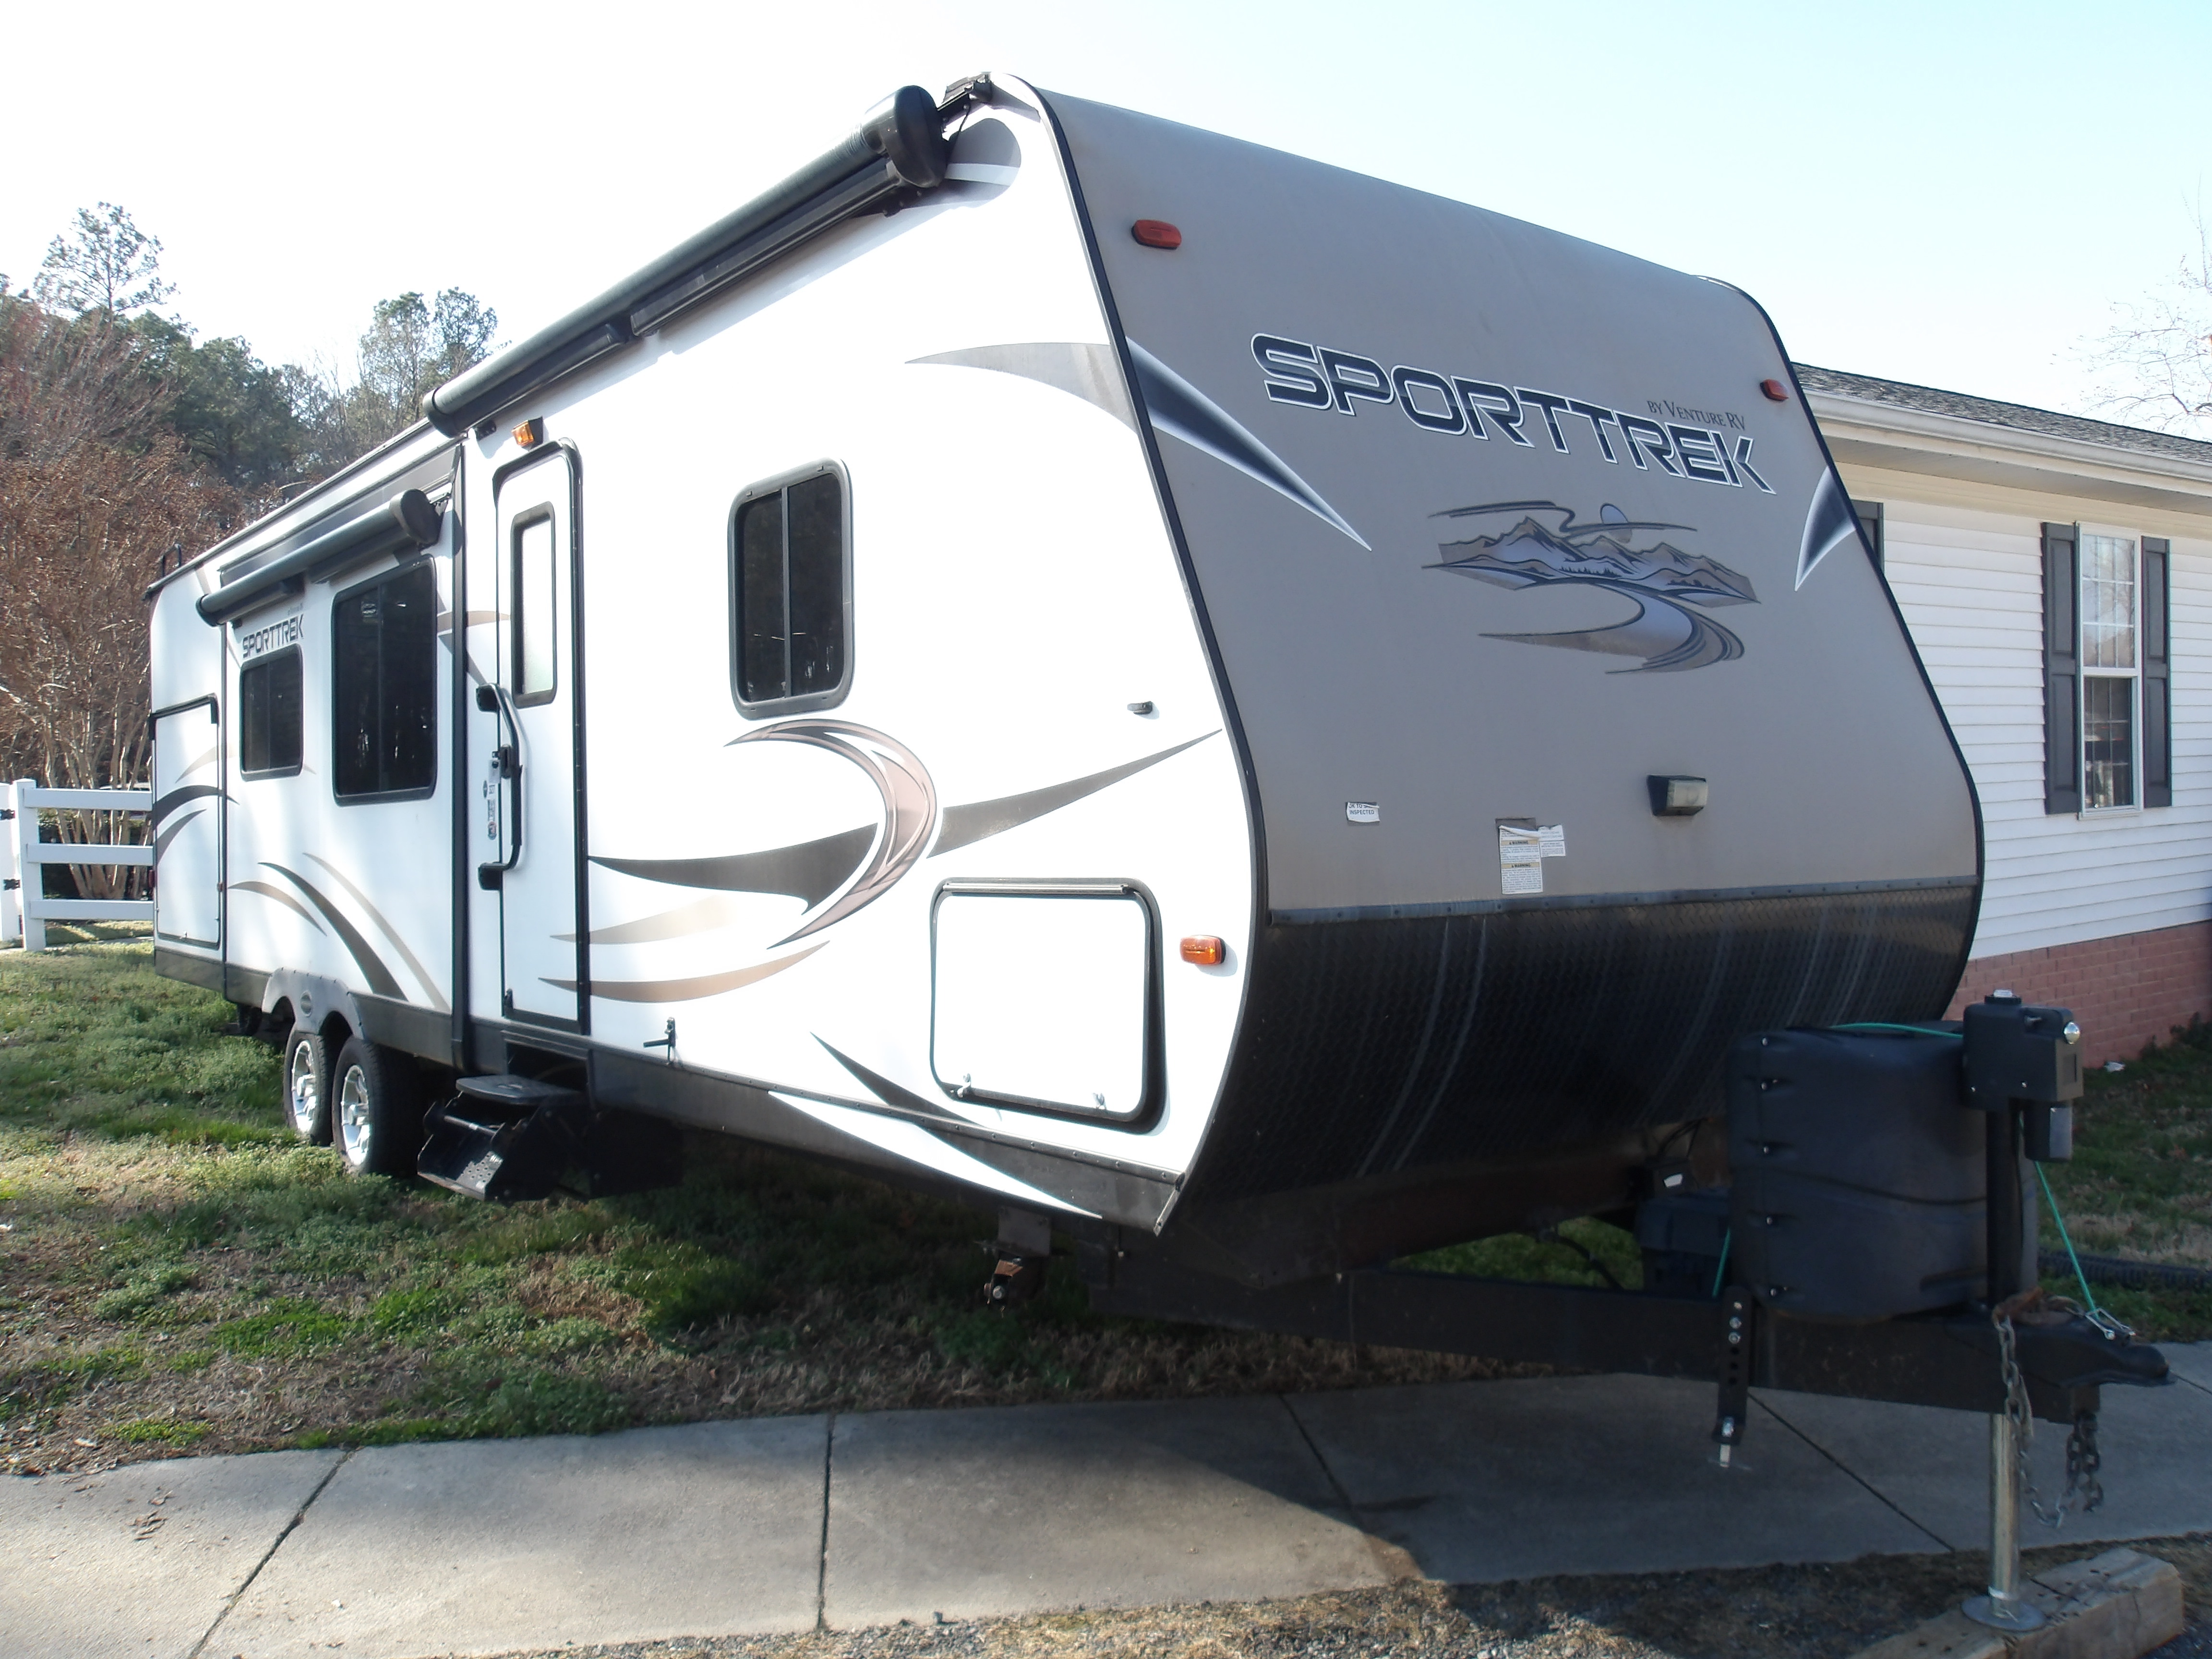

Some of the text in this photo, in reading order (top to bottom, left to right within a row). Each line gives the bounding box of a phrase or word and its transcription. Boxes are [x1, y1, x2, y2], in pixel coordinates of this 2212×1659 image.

[1250, 332, 1777, 495] SPORTTREK
[1647, 400, 1745, 431] BY VENTURE RV
[242, 613, 303, 659] SPORTTREK
